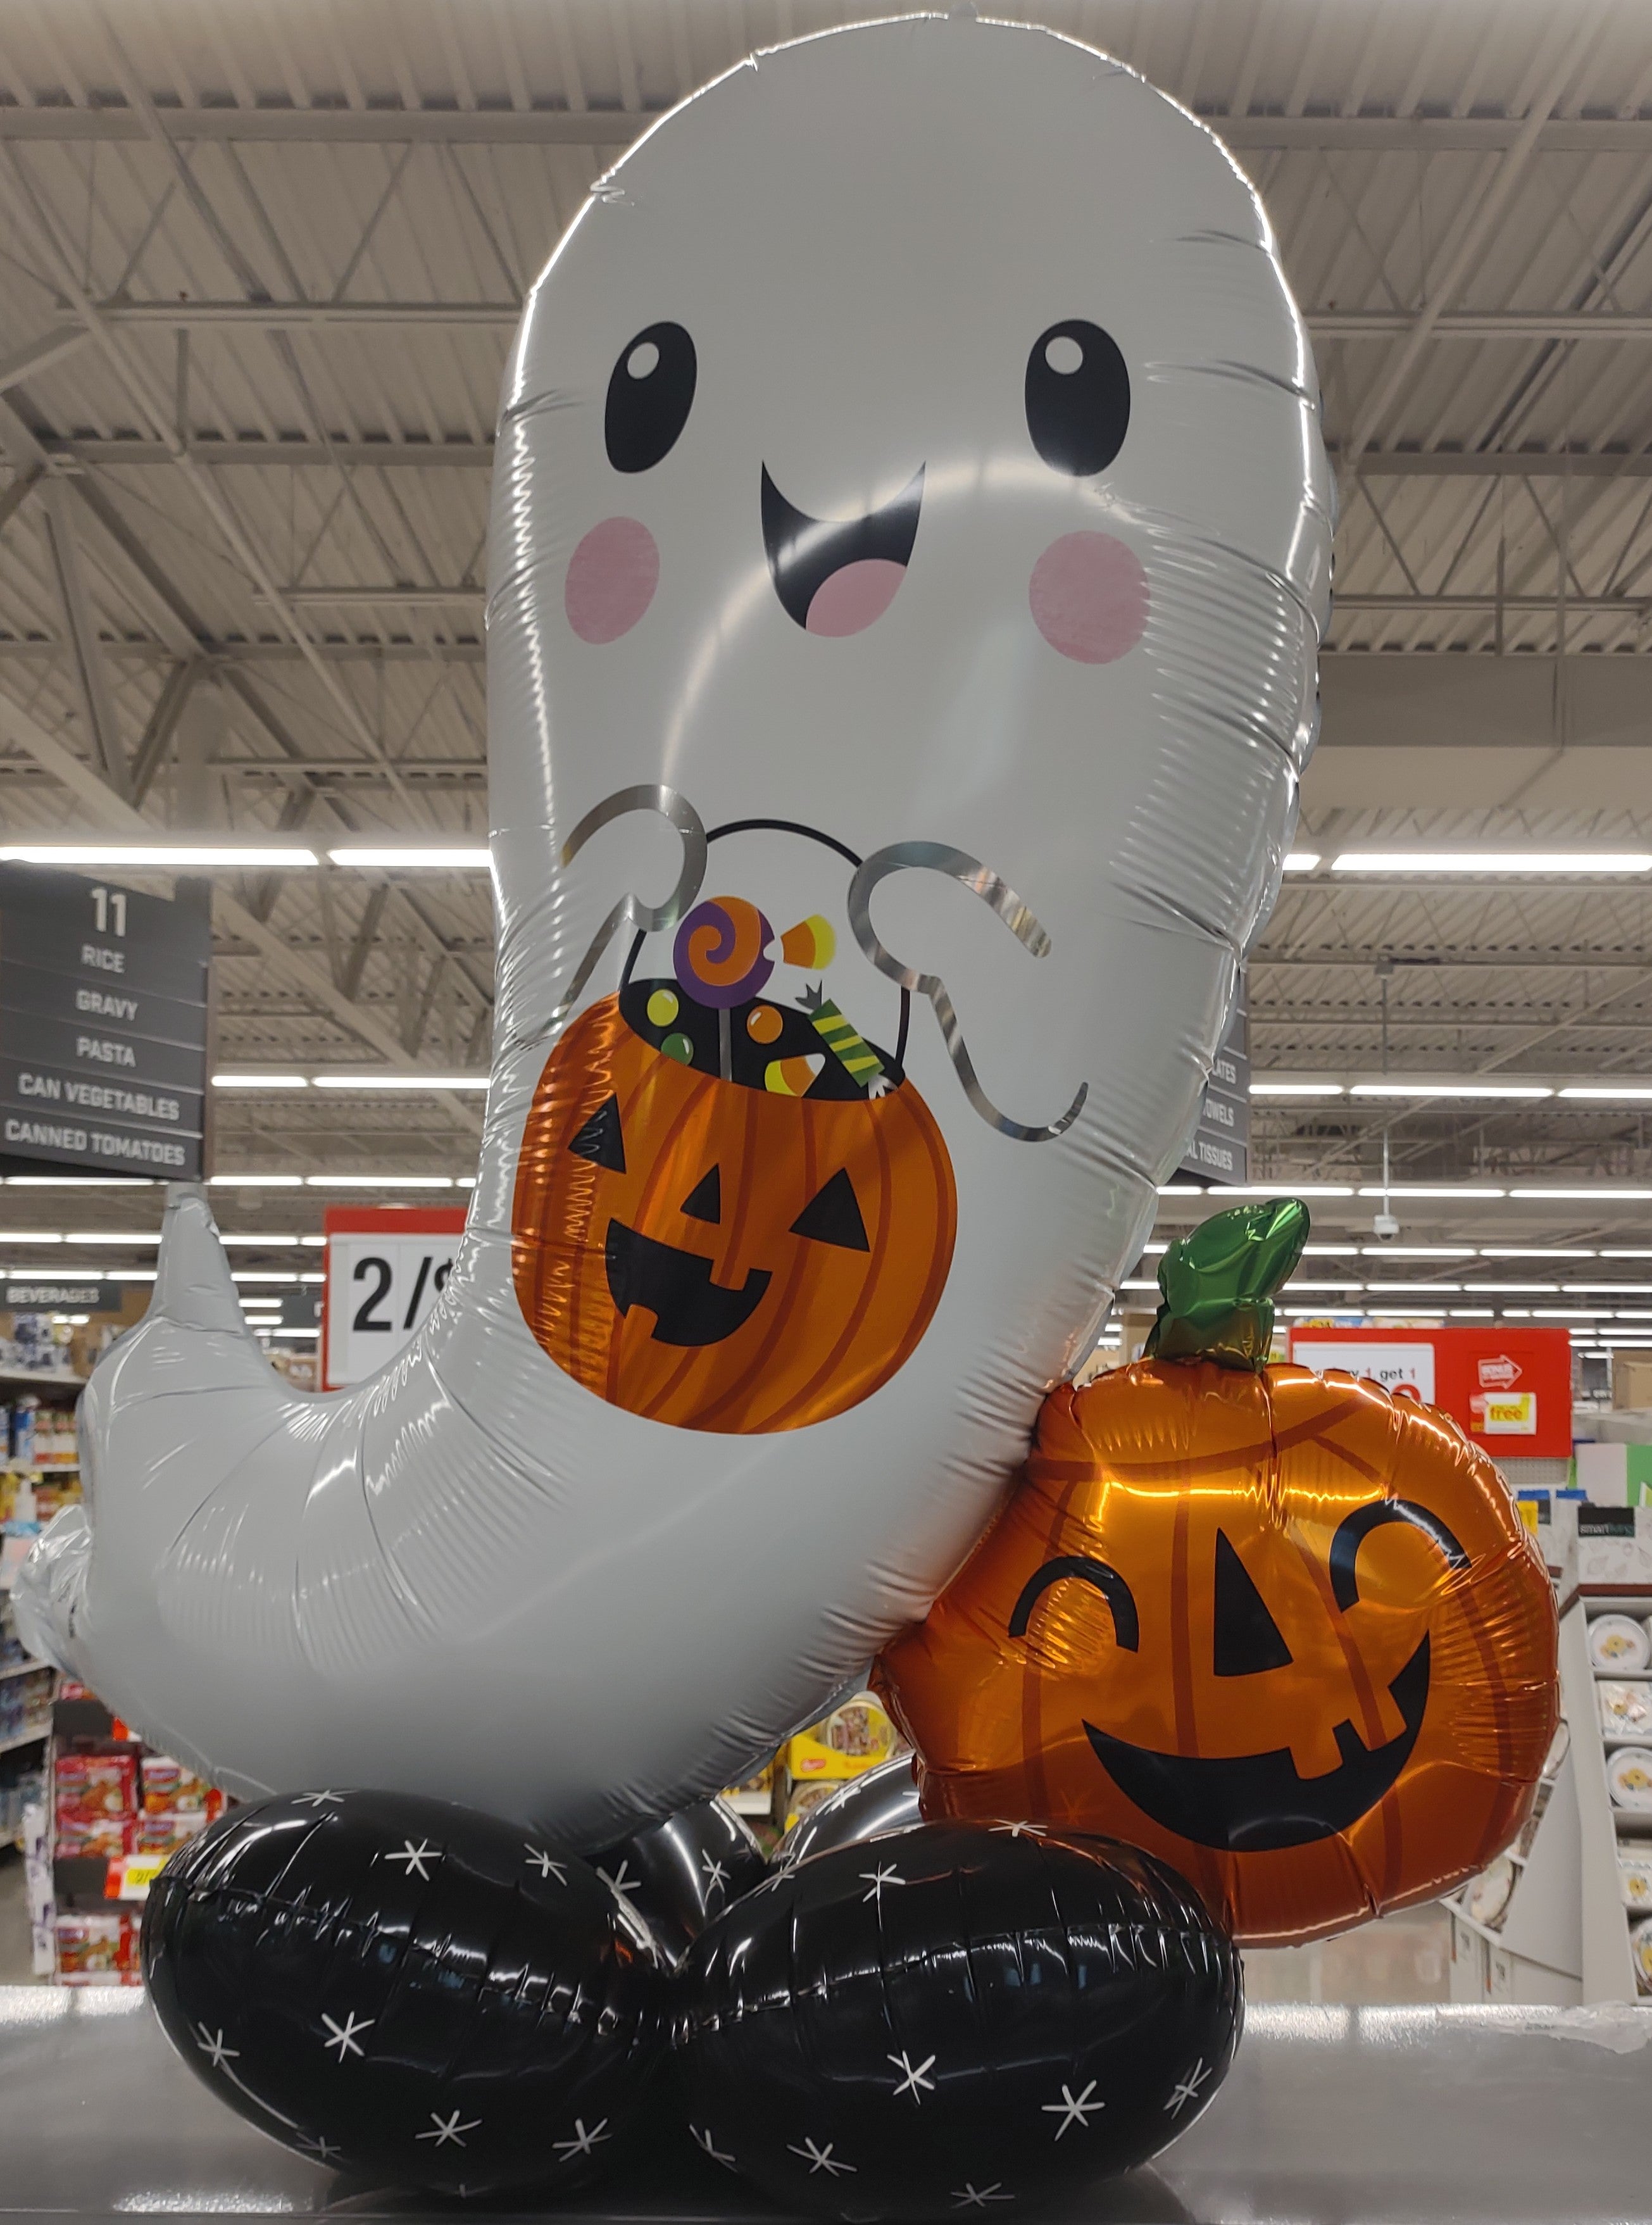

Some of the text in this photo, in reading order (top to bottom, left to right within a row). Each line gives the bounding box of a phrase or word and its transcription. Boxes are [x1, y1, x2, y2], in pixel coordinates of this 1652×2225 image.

[92, 888, 125, 937] 11
[82, 945, 125, 973] RICE
[75, 990, 137, 1021] GRAVY
[76, 1037, 136, 1067] PASTA
[1212, 1058, 1236, 1084] LATES
[18, 1073, 180, 1120] CAN VEGETABLES
[5, 1119, 185, 1165] CANNED TOMATOES
[1199, 1142, 1233, 1170] TISSUES
[6, 1286, 99, 1303] BEVERAGES
[1380, 1369, 1403, 1381] get
[1409, 1368, 1415, 1379] 1
